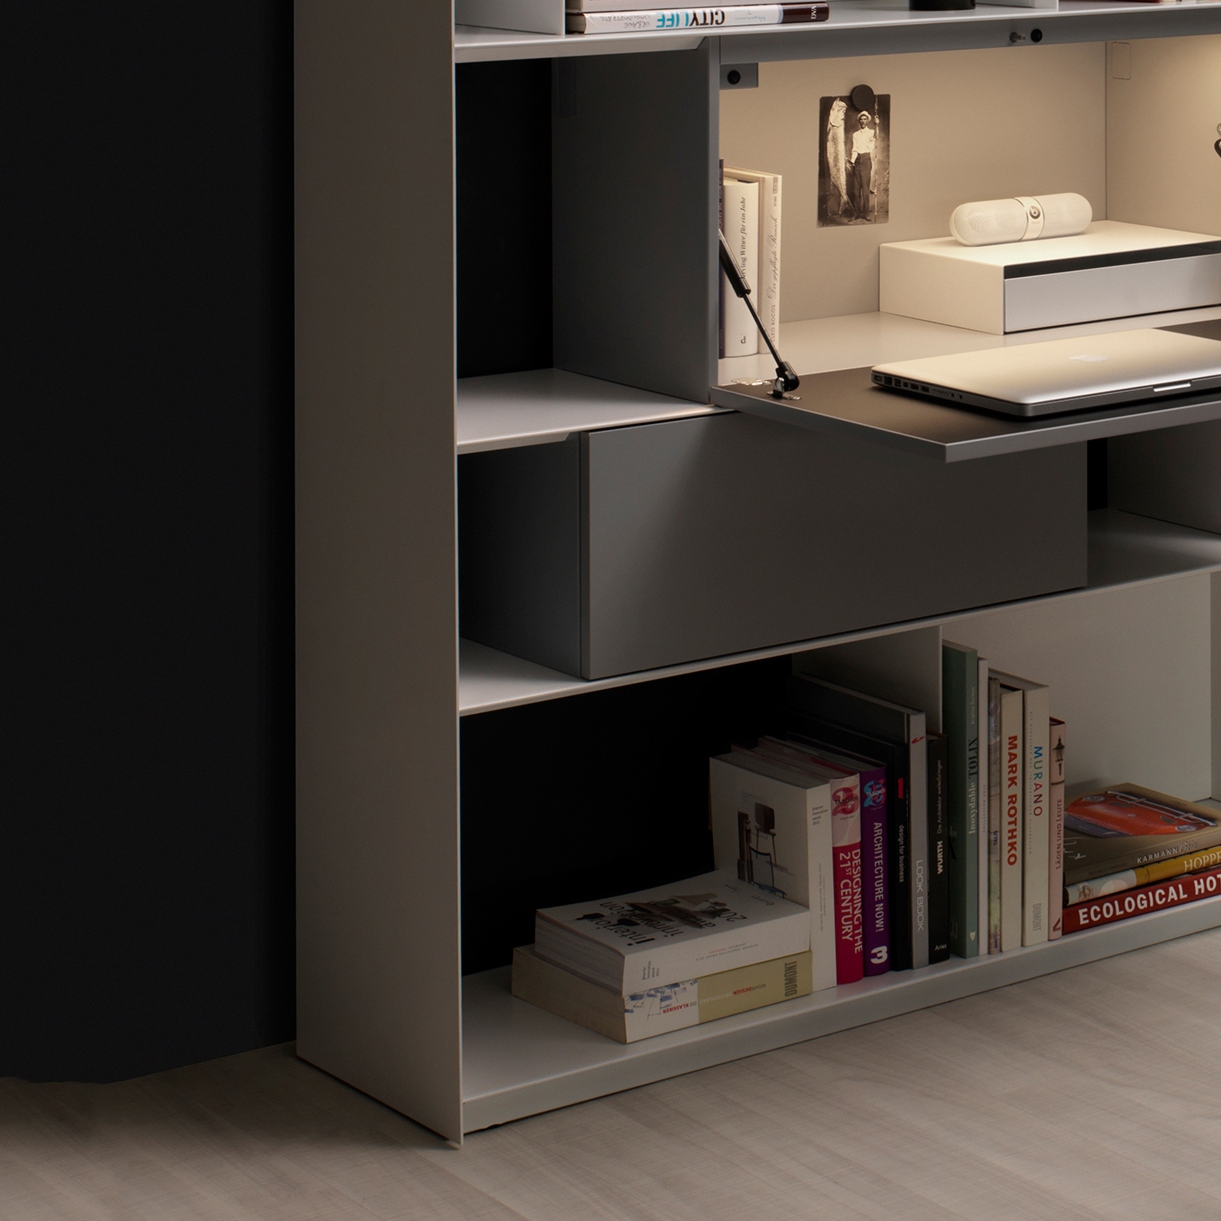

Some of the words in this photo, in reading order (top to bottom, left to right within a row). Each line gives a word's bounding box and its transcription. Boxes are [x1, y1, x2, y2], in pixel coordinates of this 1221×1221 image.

[656, 9, 726, 29] CITYLIFE
[968, 737, 978, 779] TOLIX
[1008, 735, 1018, 789] MARK
[1033, 747, 1044, 817] MURANO
[968, 783, 978, 835] Inoxydable
[1055, 799, 1063, 826] LEUTE
[898, 824, 906, 845] design
[1008, 794, 1018, 865] ROTHKO
[840, 852, 852, 875] 21ST
[873, 822, 884, 901] ARCHITECTURE
[898, 845, 906, 854] for
[1054, 843, 1063, 870] LÄDEN
[1136, 848, 1178, 864] KARMANN
[898, 855, 906, 883] business
[916, 859, 924, 893] LOOK
[852, 849, 862, 923] DESIGNING
[840, 879, 852, 941] CENTURY
[875, 903, 885, 932] NOW!
[916, 897, 925, 931] BOOK
[1032, 903, 1042, 931] DUMONT
[1078, 883, 1188, 925] ECOLOGICAL
[854, 926, 862, 953] THE
[870, 945, 888, 964] 3
[784, 961, 798, 997] DUMONT
[662, 1003, 689, 1013] KLASSIKER
